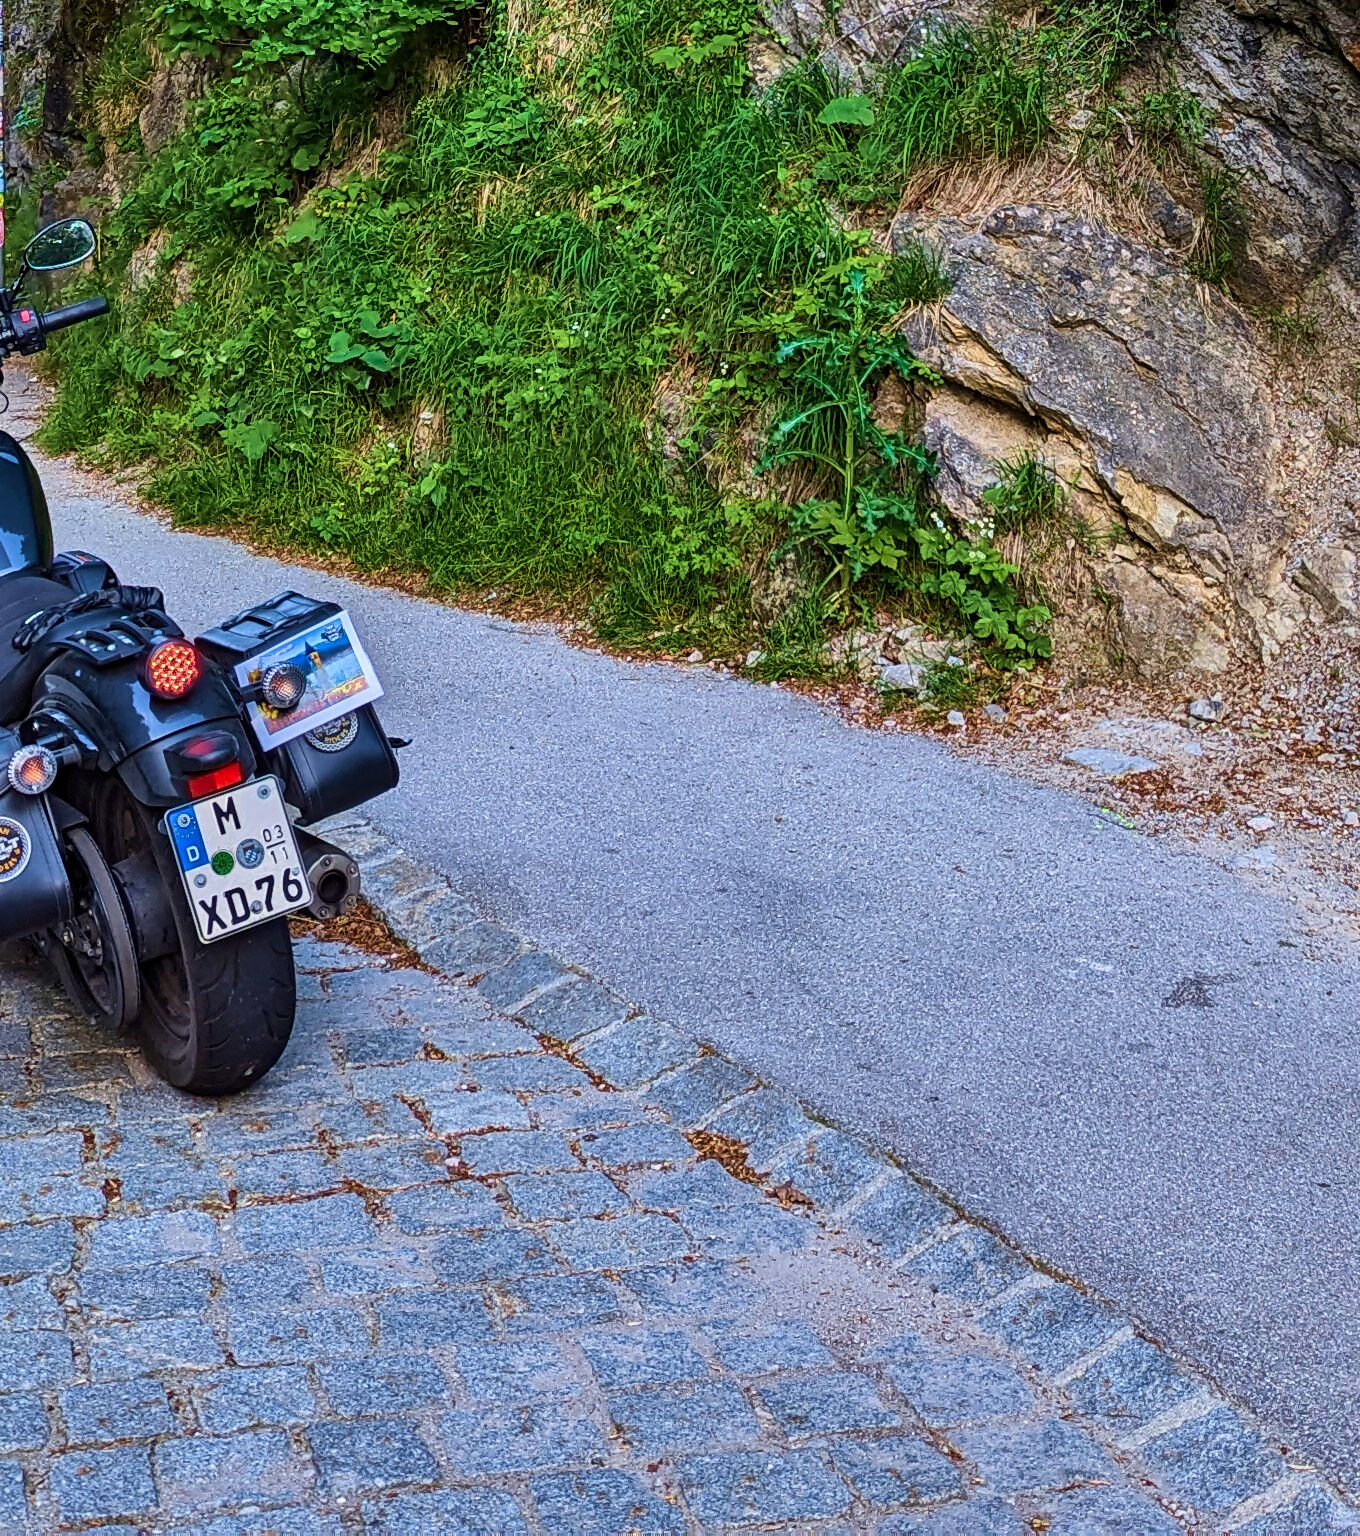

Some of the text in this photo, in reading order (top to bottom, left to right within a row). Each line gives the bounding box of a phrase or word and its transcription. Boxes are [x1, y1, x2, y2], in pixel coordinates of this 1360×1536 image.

[211, 795, 242, 836] M
[262, 824, 284, 843] 03
[185, 845, 200, 862] D
[270, 846, 289, 865] 11
[198, 867, 303, 936] XD 76
